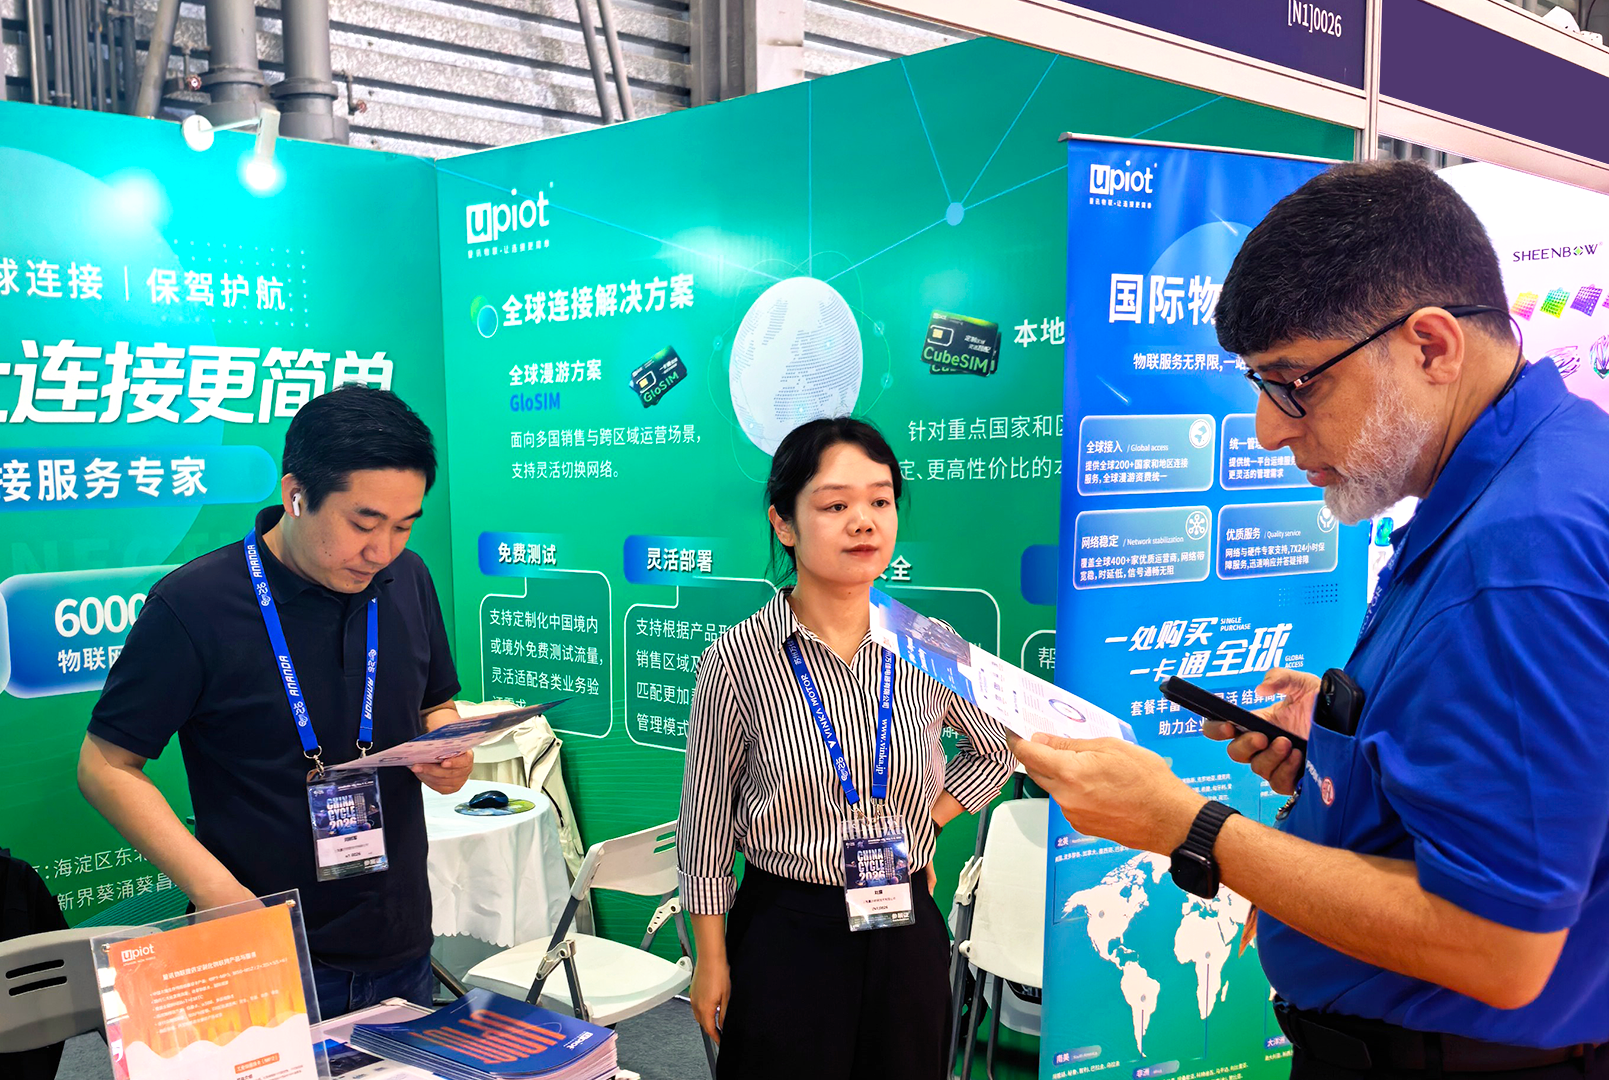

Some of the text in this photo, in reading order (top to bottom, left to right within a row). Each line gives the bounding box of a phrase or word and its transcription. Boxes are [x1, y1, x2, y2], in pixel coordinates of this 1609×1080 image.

[1287, 0, 1342, 37] [N1]0026
[1089, 160, 1153, 196] upiot
[466, 188, 549, 244] upiot
[1512, 243, 1598, 262] SHEENBOW
[146, 266, 286, 311] 保驾护航
[501, 273, 695, 328] 全球连接解决方案
[1108, 273, 1223, 326] 国际物
[1013, 316, 1065, 348] 本地
[508, 358, 602, 387] 全球漫游方案
[923, 346, 989, 373] CubeSIM
[0, 338, 394, 424] 连接更简单
[643, 371, 679, 402] GloSIM
[509, 391, 561, 413] GloSIM
[1086, 440, 1123, 454] 全球接入
[511, 459, 620, 480] 支持灵活切换网络。
[1081, 534, 1119, 549] 网络稳定
[1226, 527, 1261, 541] 优质服务
[247, 544, 263, 578] ANANDA
[497, 542, 557, 566] 免费测试
[646, 547, 713, 573] 灵活部署
[489, 609, 598, 634] 支持定制化中国境内
[1104, 616, 1242, 652] 一处购买 SINGLE
[1220, 623, 1251, 632] PURCHASE
[279, 655, 300, 697] ANANDA
[491, 666, 600, 696] 灵活适配各类业务验
[364, 676, 374, 720] ANANDA
[635, 682, 697, 706] 匹配更加
[800, 673, 834, 740] VINKA MOTOR
[635, 713, 690, 737] 管理模式
[875, 718, 888, 775] www.vinka.jp
[326, 794, 355, 810] CHINA
[327, 806, 356, 821] CYCLE
[328, 816, 357, 830] 2026
[856, 848, 884, 862] CHINA
[857, 859, 885, 873] CYCLE
[858, 871, 886, 882] 2026
[57, 872, 178, 911] 新界葵涌葵昌
[121, 943, 155, 963] upiot
